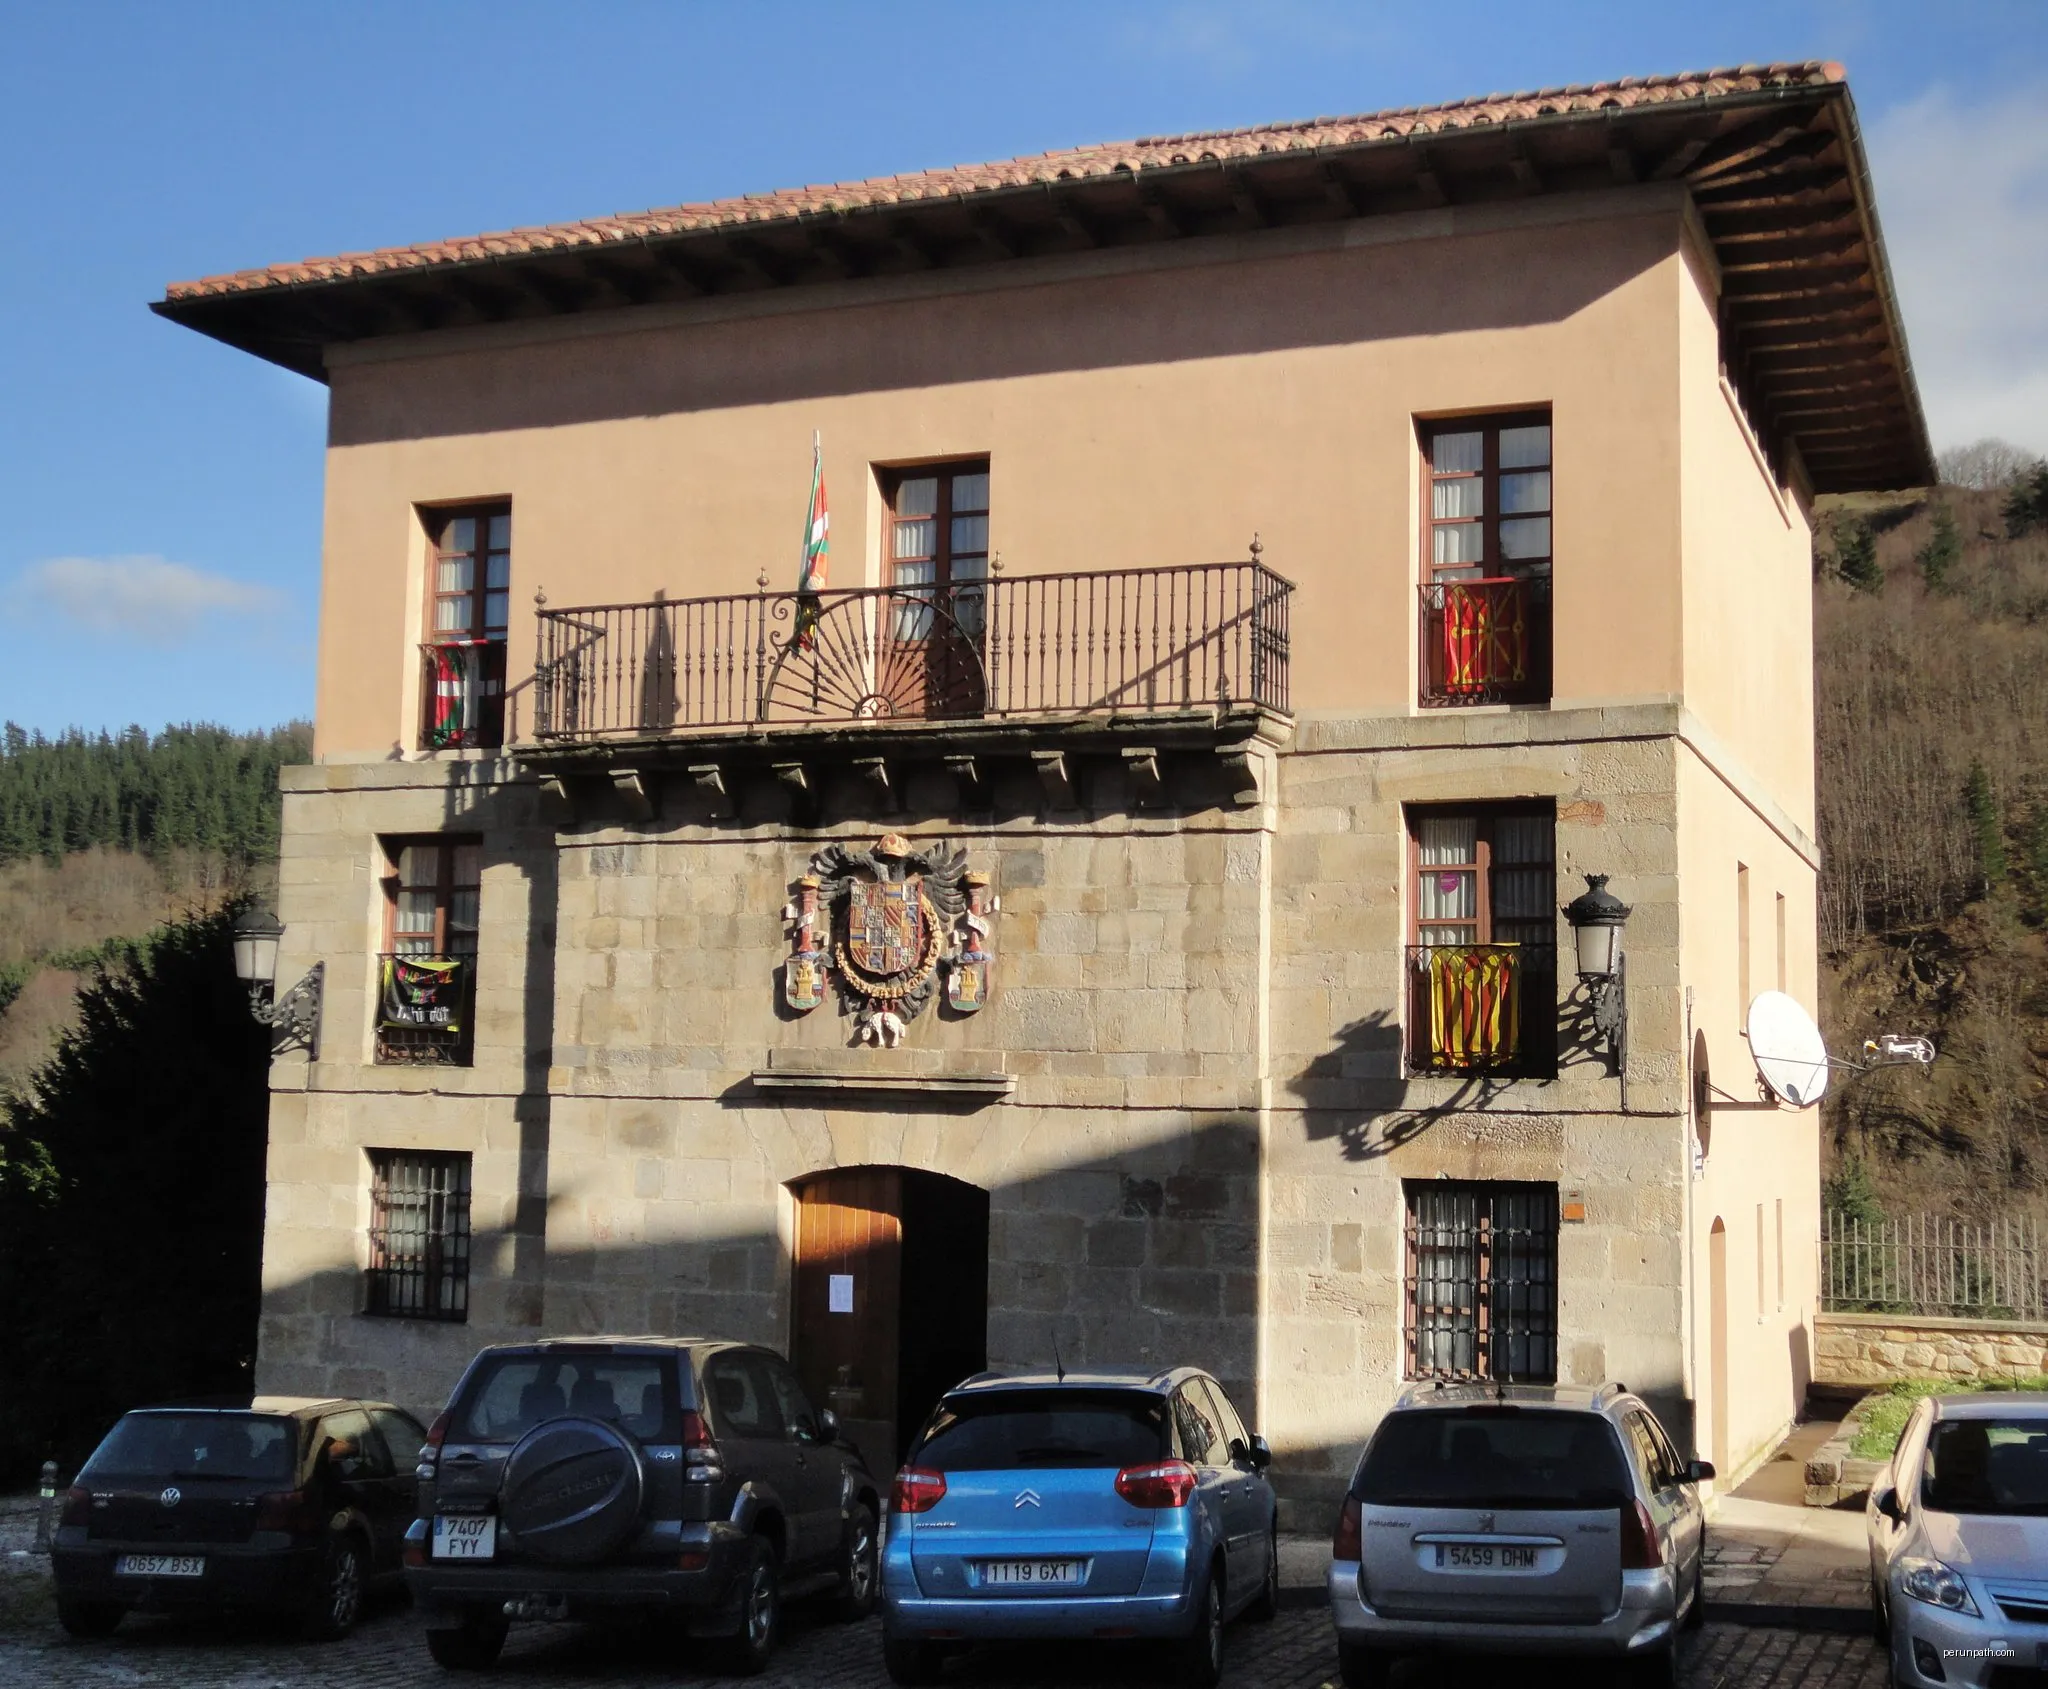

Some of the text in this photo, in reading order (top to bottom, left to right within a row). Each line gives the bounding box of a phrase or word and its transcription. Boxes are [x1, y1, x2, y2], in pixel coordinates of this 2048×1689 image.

[447, 1519, 487, 1536] 7407
[449, 1539, 479, 1555] FYY
[127, 1557, 203, 1574] 0657 BSX
[1450, 1548, 1534, 1568] 5459 DHM
[993, 1564, 1069, 1581] 1119 GXT
